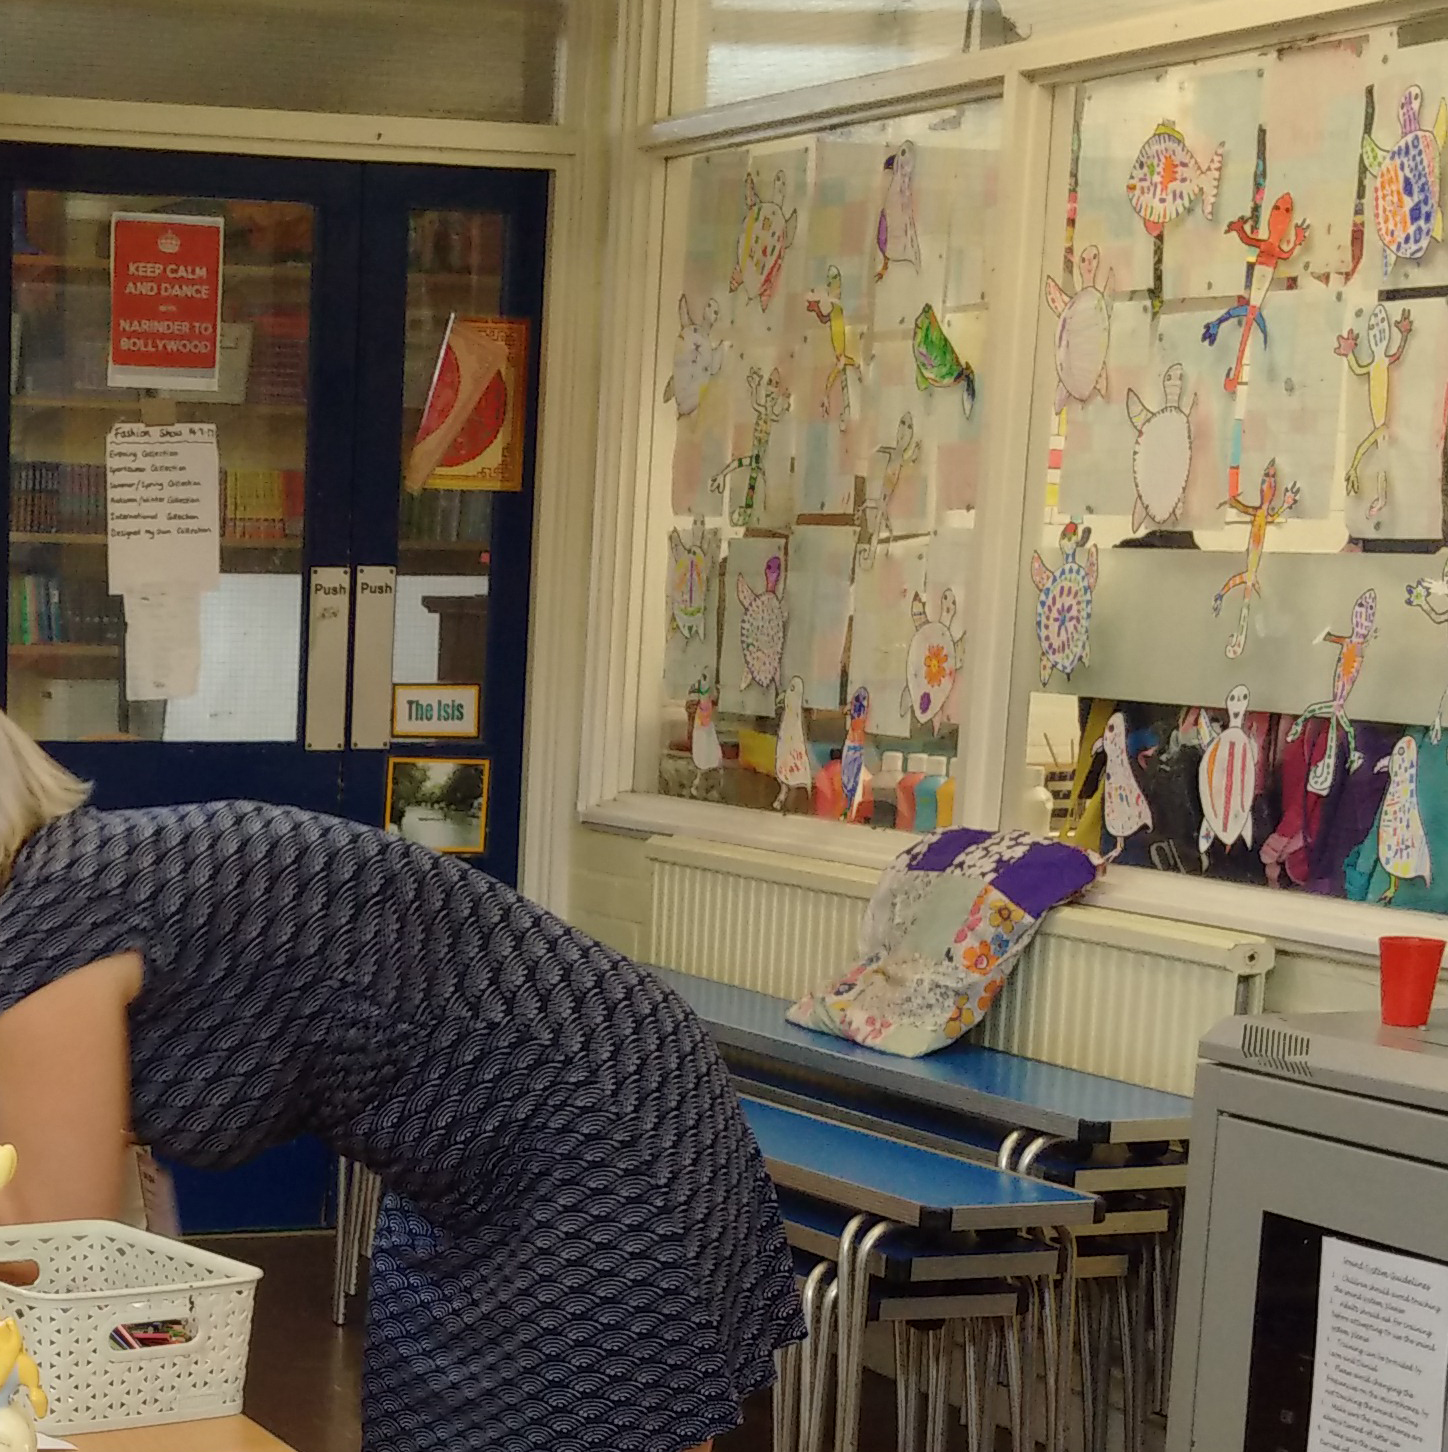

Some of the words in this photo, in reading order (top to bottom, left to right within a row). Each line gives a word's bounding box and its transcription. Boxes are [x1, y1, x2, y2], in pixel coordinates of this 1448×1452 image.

[128, 262, 163, 277] KEEP
[166, 265, 207, 280] CALM
[125, 281, 158, 296] AND
[161, 284, 210, 299] DANCE
[119, 319, 190, 334] NARINDER
[193, 323, 213, 335] TO
[120, 338, 211, 353] BOLLYWOOD
[114, 427, 152, 439] Fashion
[159, 428, 183, 438] Show
[314, 583, 346, 595] Push
[360, 582, 392, 594] Push
[406, 700, 434, 721] The
[437, 700, 464, 721] Isis
